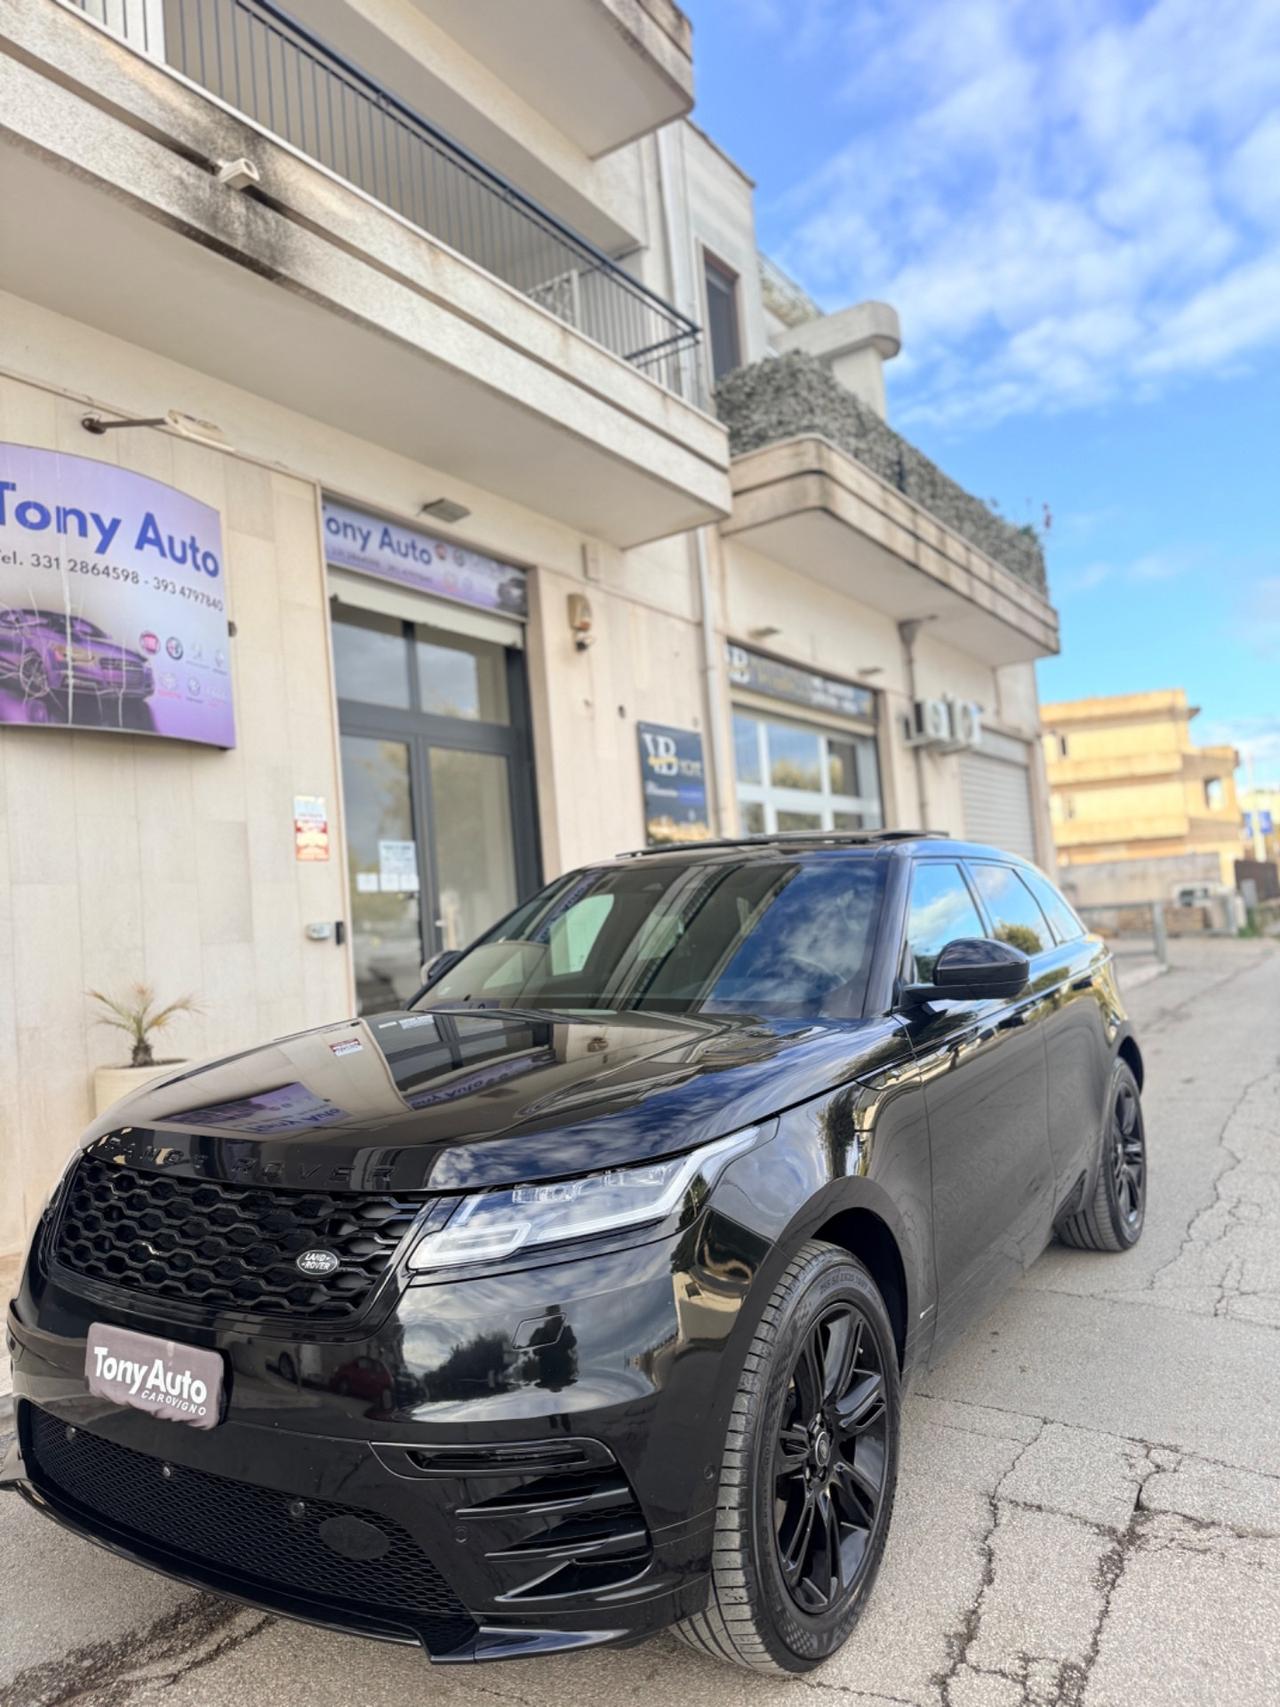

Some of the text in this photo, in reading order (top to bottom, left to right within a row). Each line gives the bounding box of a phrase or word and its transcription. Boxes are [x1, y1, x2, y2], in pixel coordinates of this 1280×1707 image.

[0, 480, 220, 579] Tony Auto
[322, 504, 372, 552] ony
[379, 527, 433, 566] Auto
[0, 549, 23, 566] el.
[31, 553, 60, 571] 331
[68, 558, 140, 585] 2864598
[153, 576, 176, 594] 393
[305, 1253, 326, 1261] LAND
[305, 1261, 331, 1270] ROVER
[141, 1389, 207, 1416] CAROVIGNO
